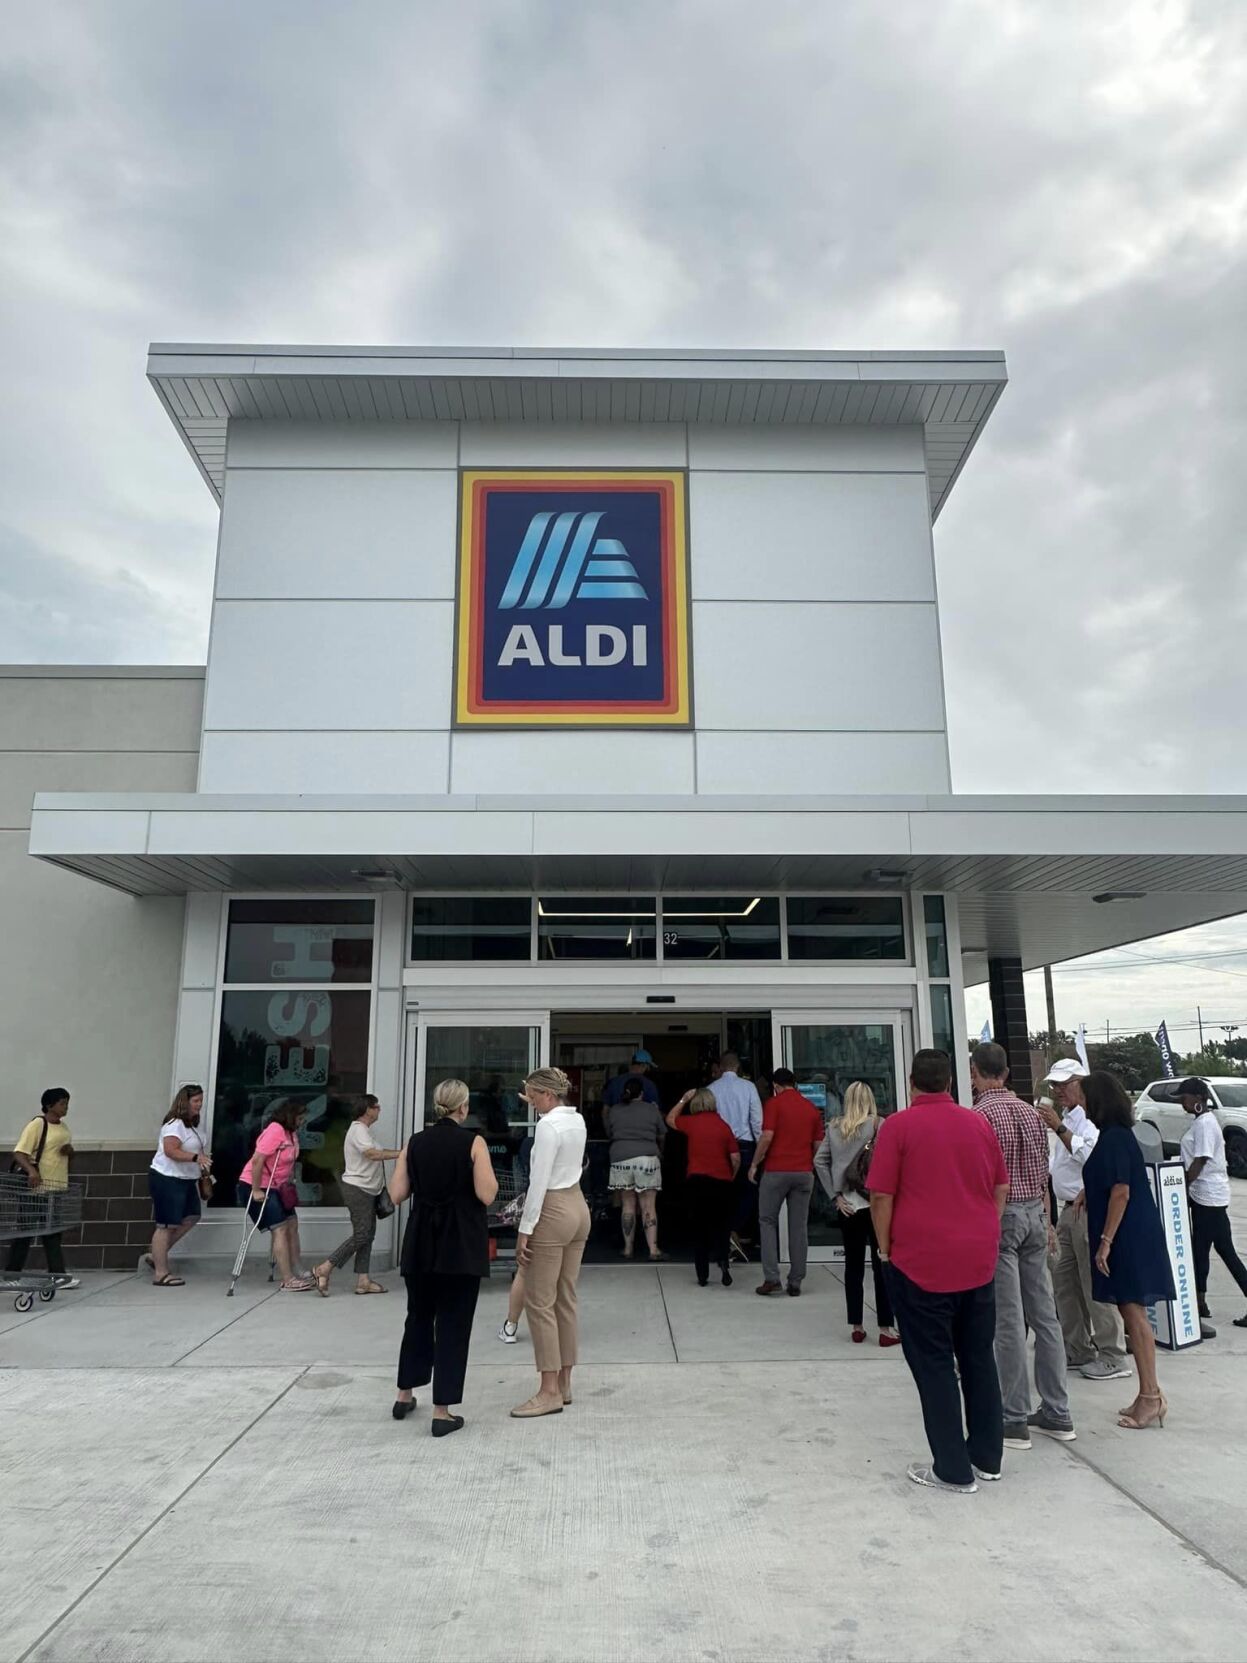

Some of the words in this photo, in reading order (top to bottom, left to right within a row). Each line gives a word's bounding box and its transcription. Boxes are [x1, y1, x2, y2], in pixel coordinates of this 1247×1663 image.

[497, 624, 647, 667] ALDI
[664, 932, 678, 945] 32
[1170, 1191, 1186, 1259] ORDER
[1178, 1263, 1194, 1338] ONLINE
